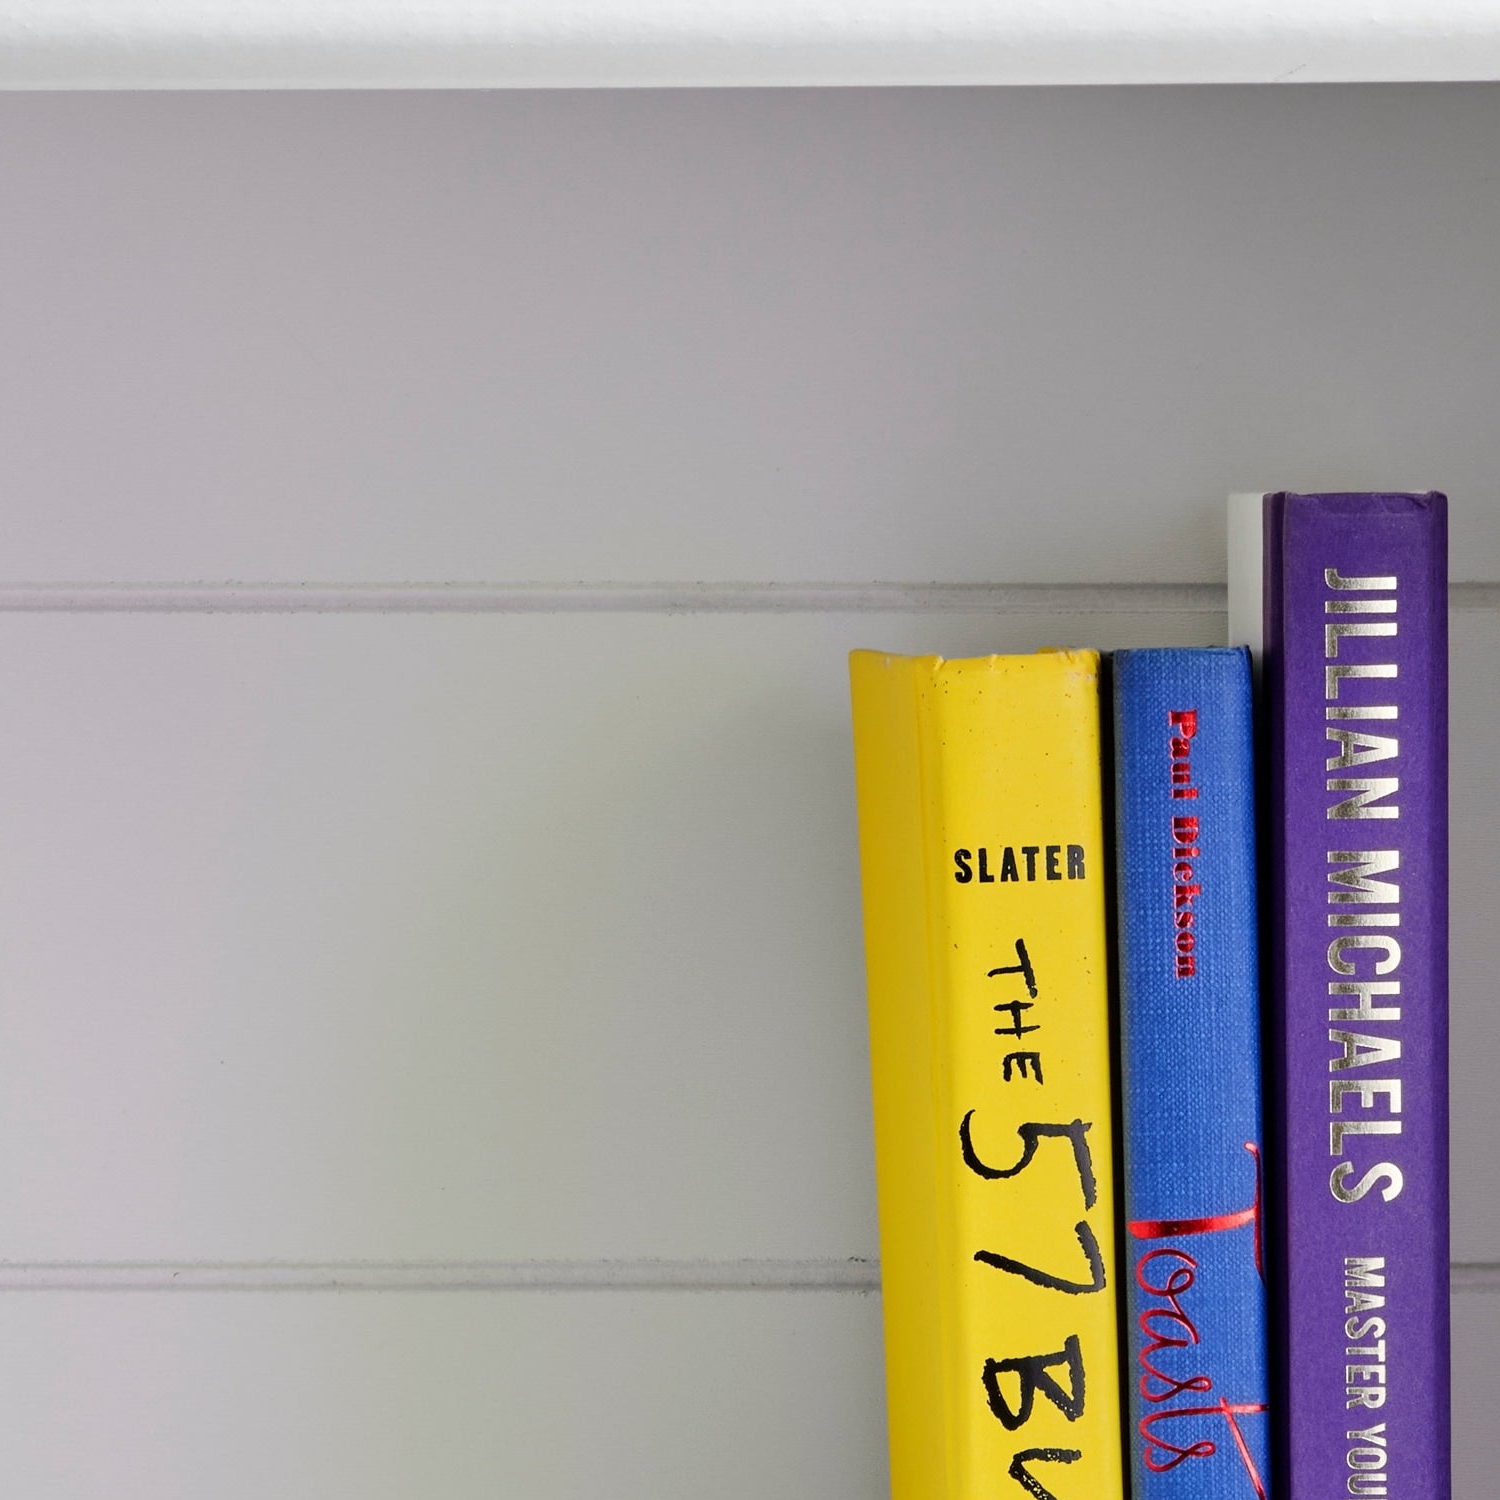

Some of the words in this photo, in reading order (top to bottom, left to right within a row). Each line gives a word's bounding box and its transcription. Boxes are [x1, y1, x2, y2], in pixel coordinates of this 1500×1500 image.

[1168, 708, 1199, 800] Paul
[1325, 567, 1400, 820] JILLIAN
[954, 844, 1086, 884] SLATER
[1171, 815, 1201, 979] Dickson
[987, 938, 1044, 1085] THE
[1326, 849, 1405, 1204] MICHAELS
[958, 1108, 1107, 1296] 57
[1343, 1256, 1387, 1410] MASTER
